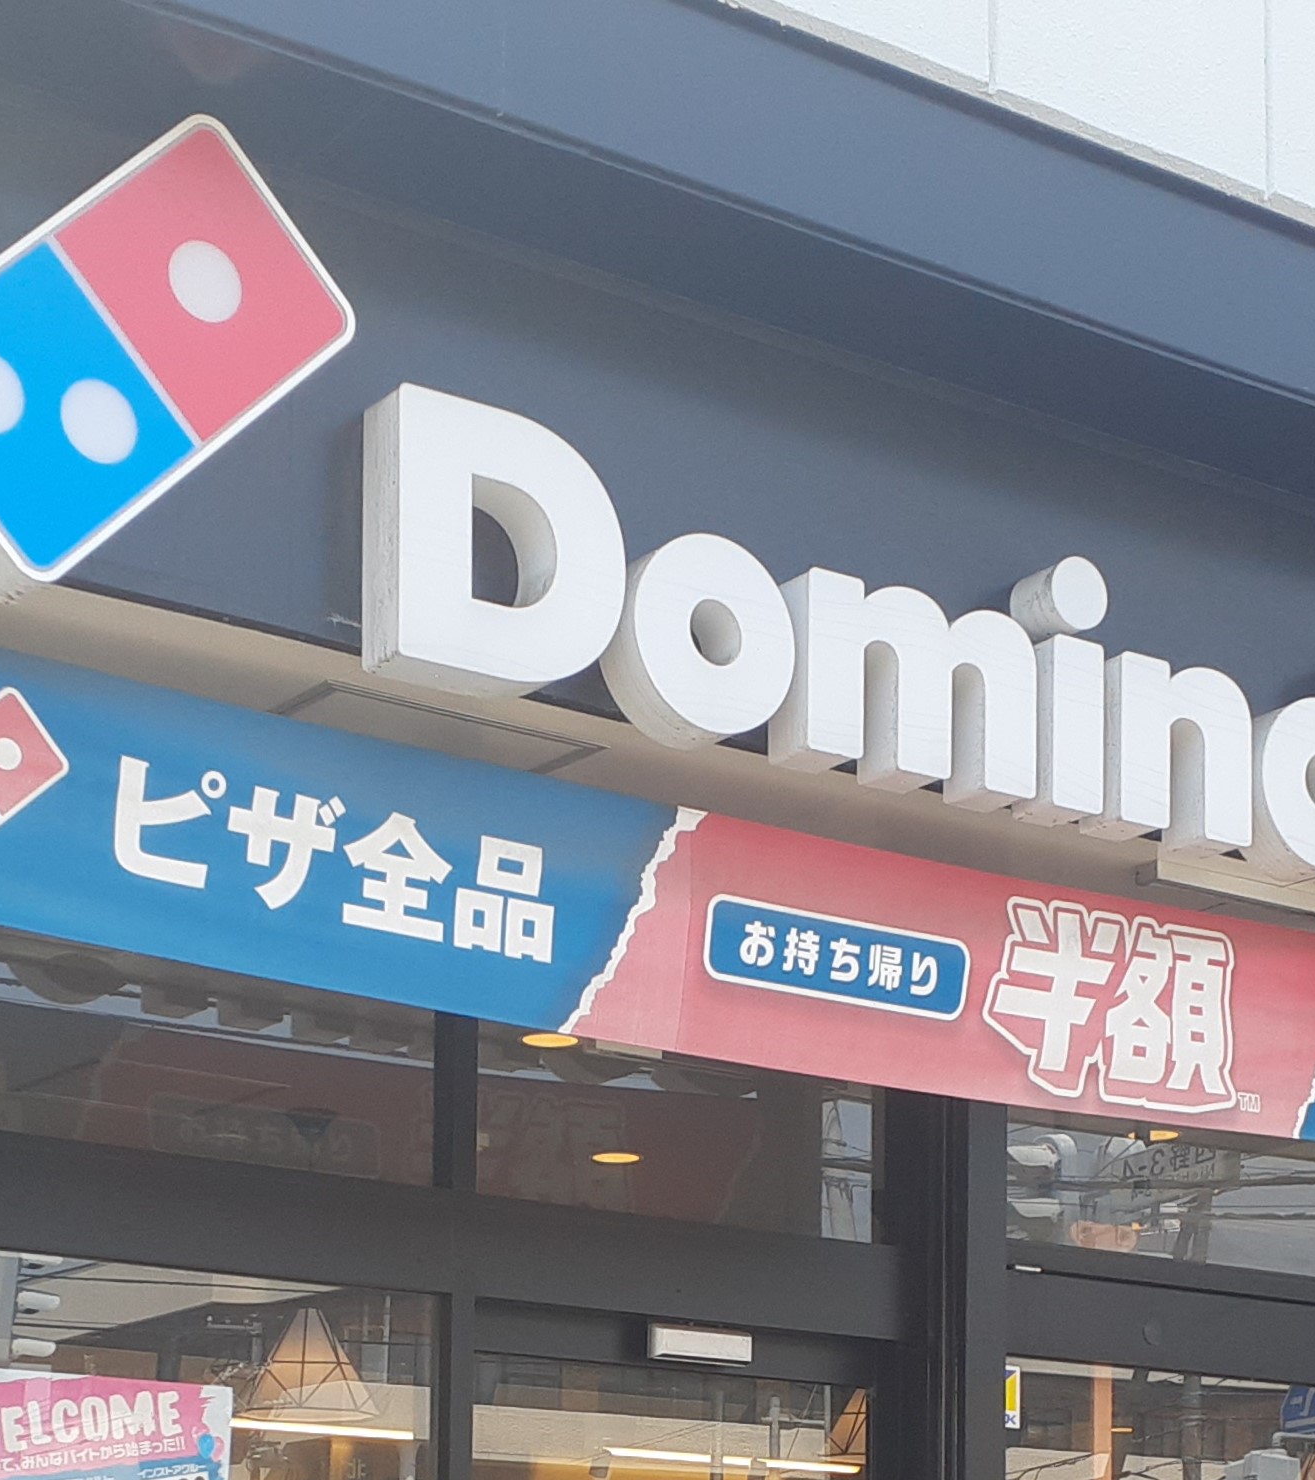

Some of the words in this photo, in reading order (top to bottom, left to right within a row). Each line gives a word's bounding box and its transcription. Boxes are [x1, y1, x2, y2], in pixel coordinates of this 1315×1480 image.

[110, 753, 558, 967] ピザ全品
[738, 919, 941, 999] お持ち帰り
[990, 900, 1233, 1108] 半額
